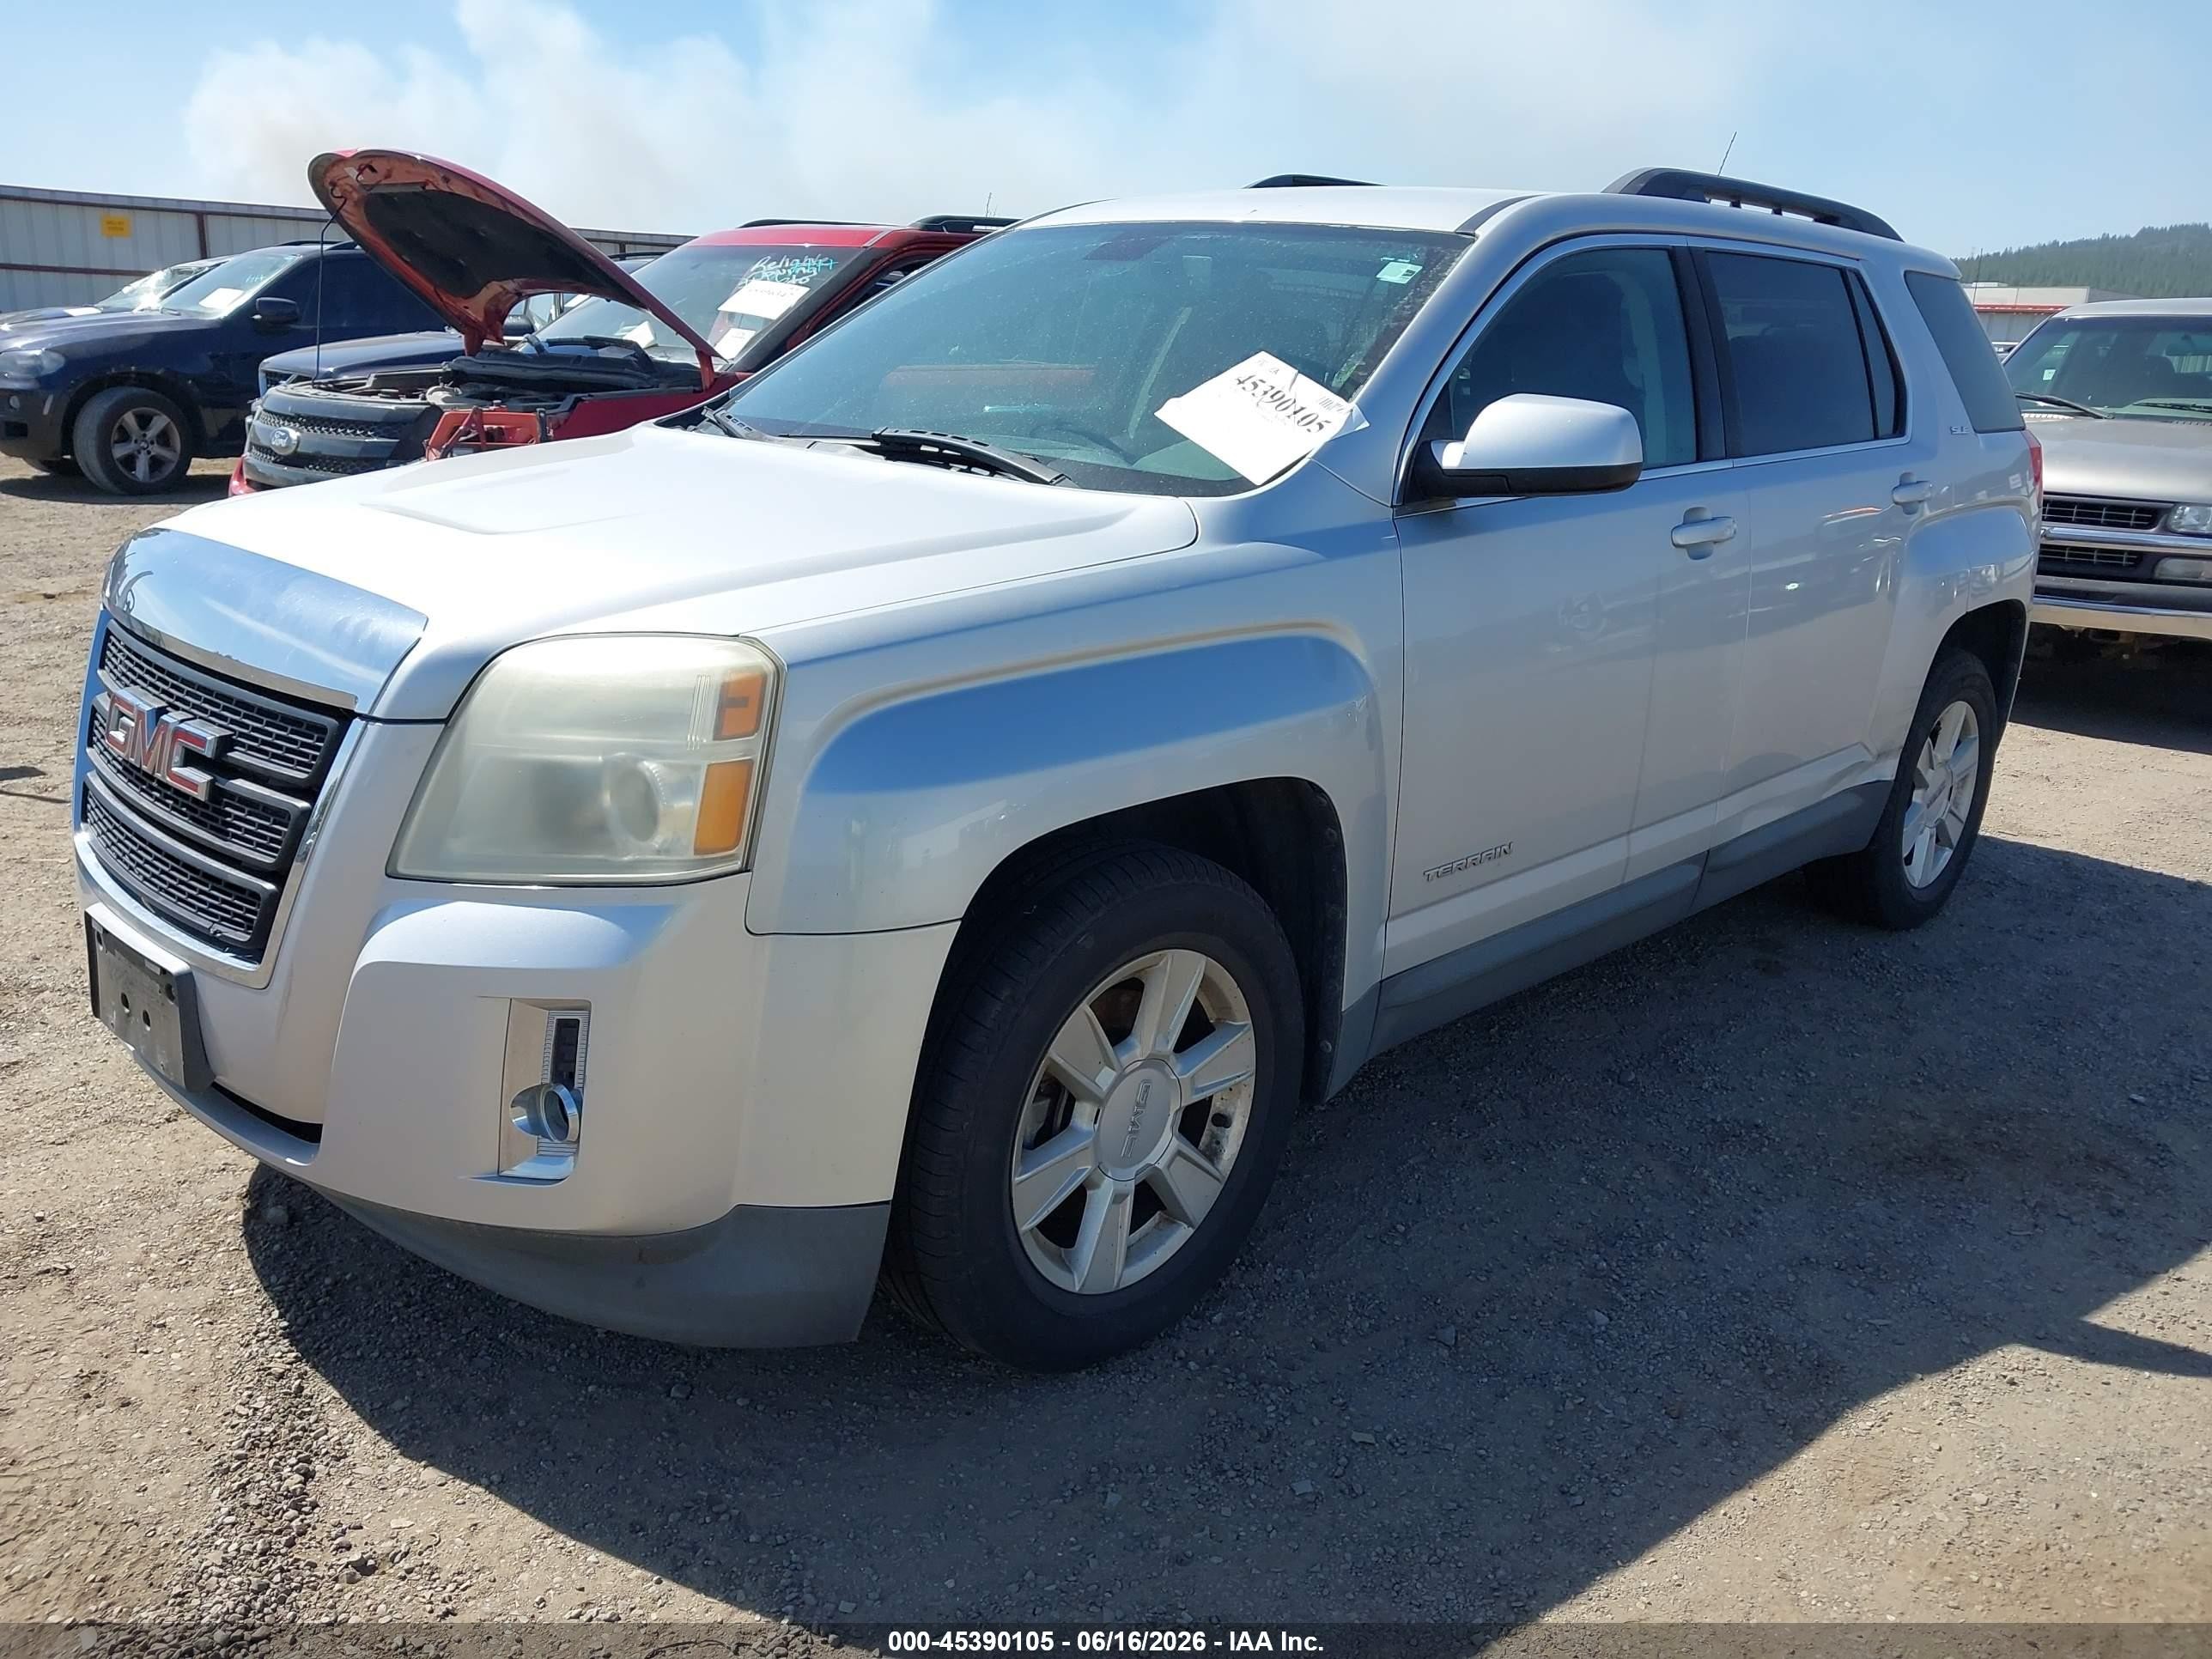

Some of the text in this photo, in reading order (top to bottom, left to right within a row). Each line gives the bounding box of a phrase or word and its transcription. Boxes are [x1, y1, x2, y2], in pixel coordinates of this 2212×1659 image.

[1235, 374, 1332, 433] 45390105
[270, 430, 290, 447] Ford
[106, 687, 228, 802] GMC
[1423, 841, 1513, 882] TERRAIN
[1120, 1079, 1152, 1159] GMC
